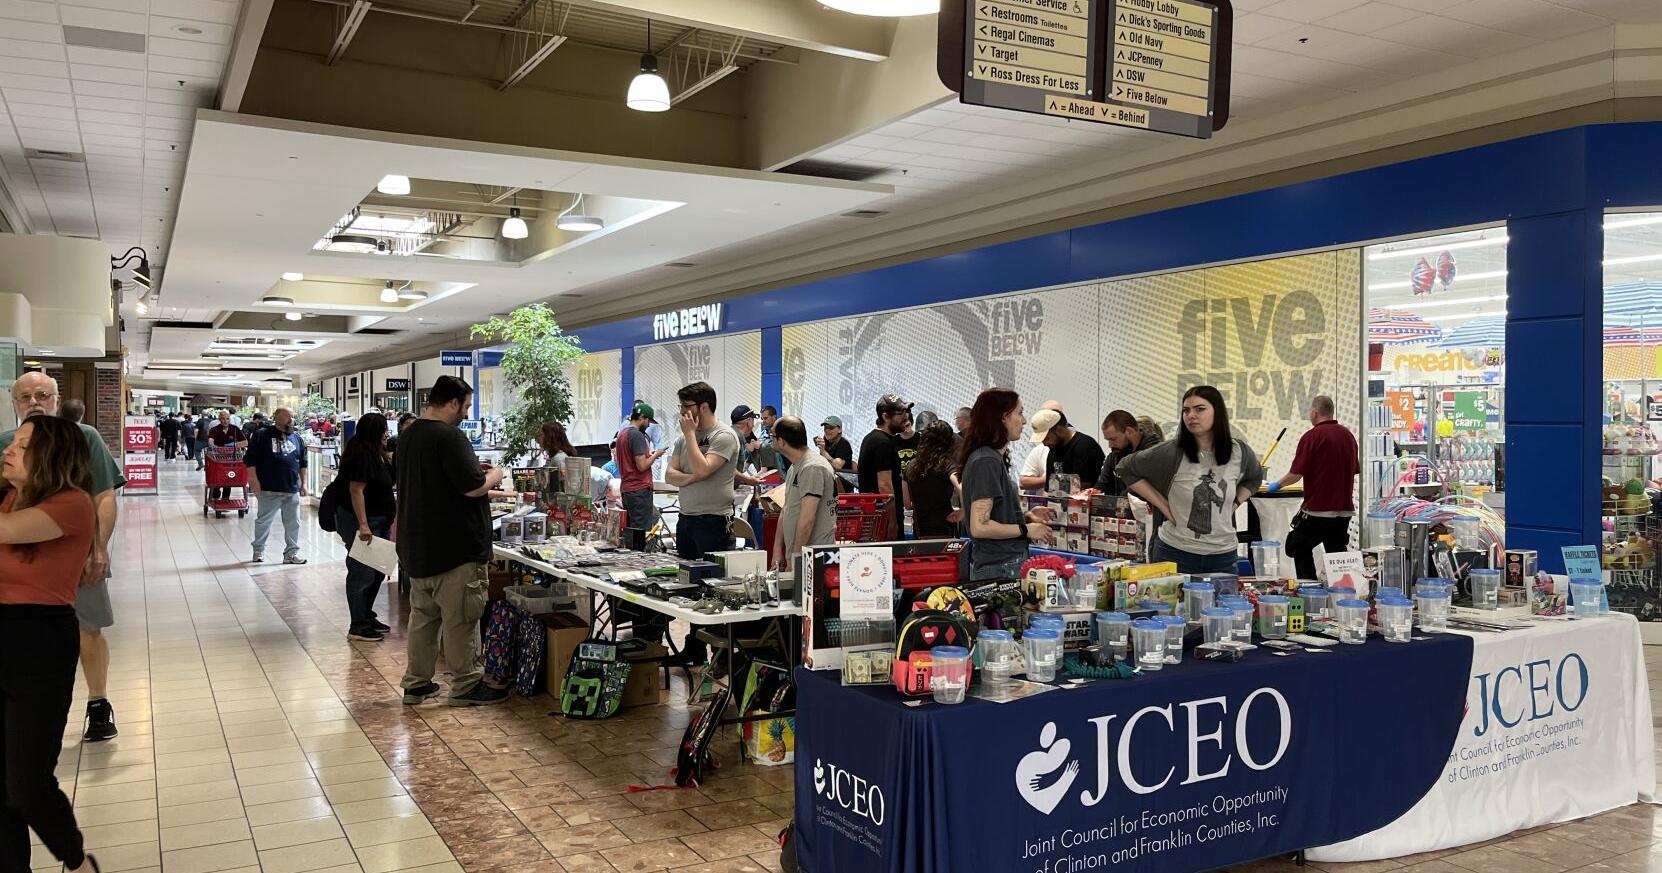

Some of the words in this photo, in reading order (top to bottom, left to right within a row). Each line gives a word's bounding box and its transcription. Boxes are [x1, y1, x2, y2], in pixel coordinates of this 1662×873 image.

[1036, 0, 1067, 11] Service
[1157, 3, 1179, 17] Lobby
[991, 6, 1039, 25] Restrooms
[1041, 19, 1068, 31] Toilettes
[1129, 13, 1151, 28] Dick's
[1153, 18, 1182, 36] Sporting
[1184, 25, 1206, 39] Goods
[991, 25, 1015, 42] Regal
[1018, 30, 1055, 48] Cinemas
[1129, 31, 1142, 43] Old
[1145, 36, 1163, 50] Navy
[991, 46, 1018, 62] Target
[1127, 51, 1163, 69] JCPenney
[991, 67, 1012, 81] Ross
[1016, 71, 1040, 85] Dress
[1043, 75, 1057, 87] For
[1060, 77, 1079, 91] Less
[1126, 69, 1145, 82] DSW
[1127, 88, 1143, 101] Five
[1145, 91, 1168, 106] Below
[1068, 102, 1095, 116] Ahead
[1118, 110, 1145, 124] Behind
[653, 311, 679, 340] five
[680, 302, 721, 336] BELOW
[991, 298, 1043, 334] five
[1177, 289, 1326, 370] five
[688, 344, 711, 366] five
[991, 331, 1041, 357] BELOW
[577, 367, 603, 399] five
[1400, 398, 1409, 411] $2
[1473, 399, 1485, 412] $5
[128, 472, 152, 480] FREE
[1064, 629, 1091, 638] WARS
[1066, 620, 1091, 630] STAR
[1473, 652, 1589, 737] JCEO
[1079, 687, 1291, 807] JCEO
[1460, 740, 1492, 761] Council
[1506, 730, 1541, 748] Economic
[1541, 717, 1584, 737] Opportunity
[1448, 768, 1457, 783] of
[1460, 763, 1489, 781] Clinton
[826, 763, 884, 826] JCEO
[1022, 835, 1055, 859] Joint
[1061, 818, 1117, 849] Council
[1120, 815, 1139, 835] for
[1141, 801, 1208, 829] Economic
[1212, 786, 1289, 817] Opportunity
[1034, 858, 1049, 873] of
[1054, 847, 1107, 873] Clinton
[1111, 838, 1138, 864] and
[1140, 830, 1192, 855] Franklin
[1196, 818, 1255, 843] Counties,
[1257, 811, 1280, 829] Inc.
